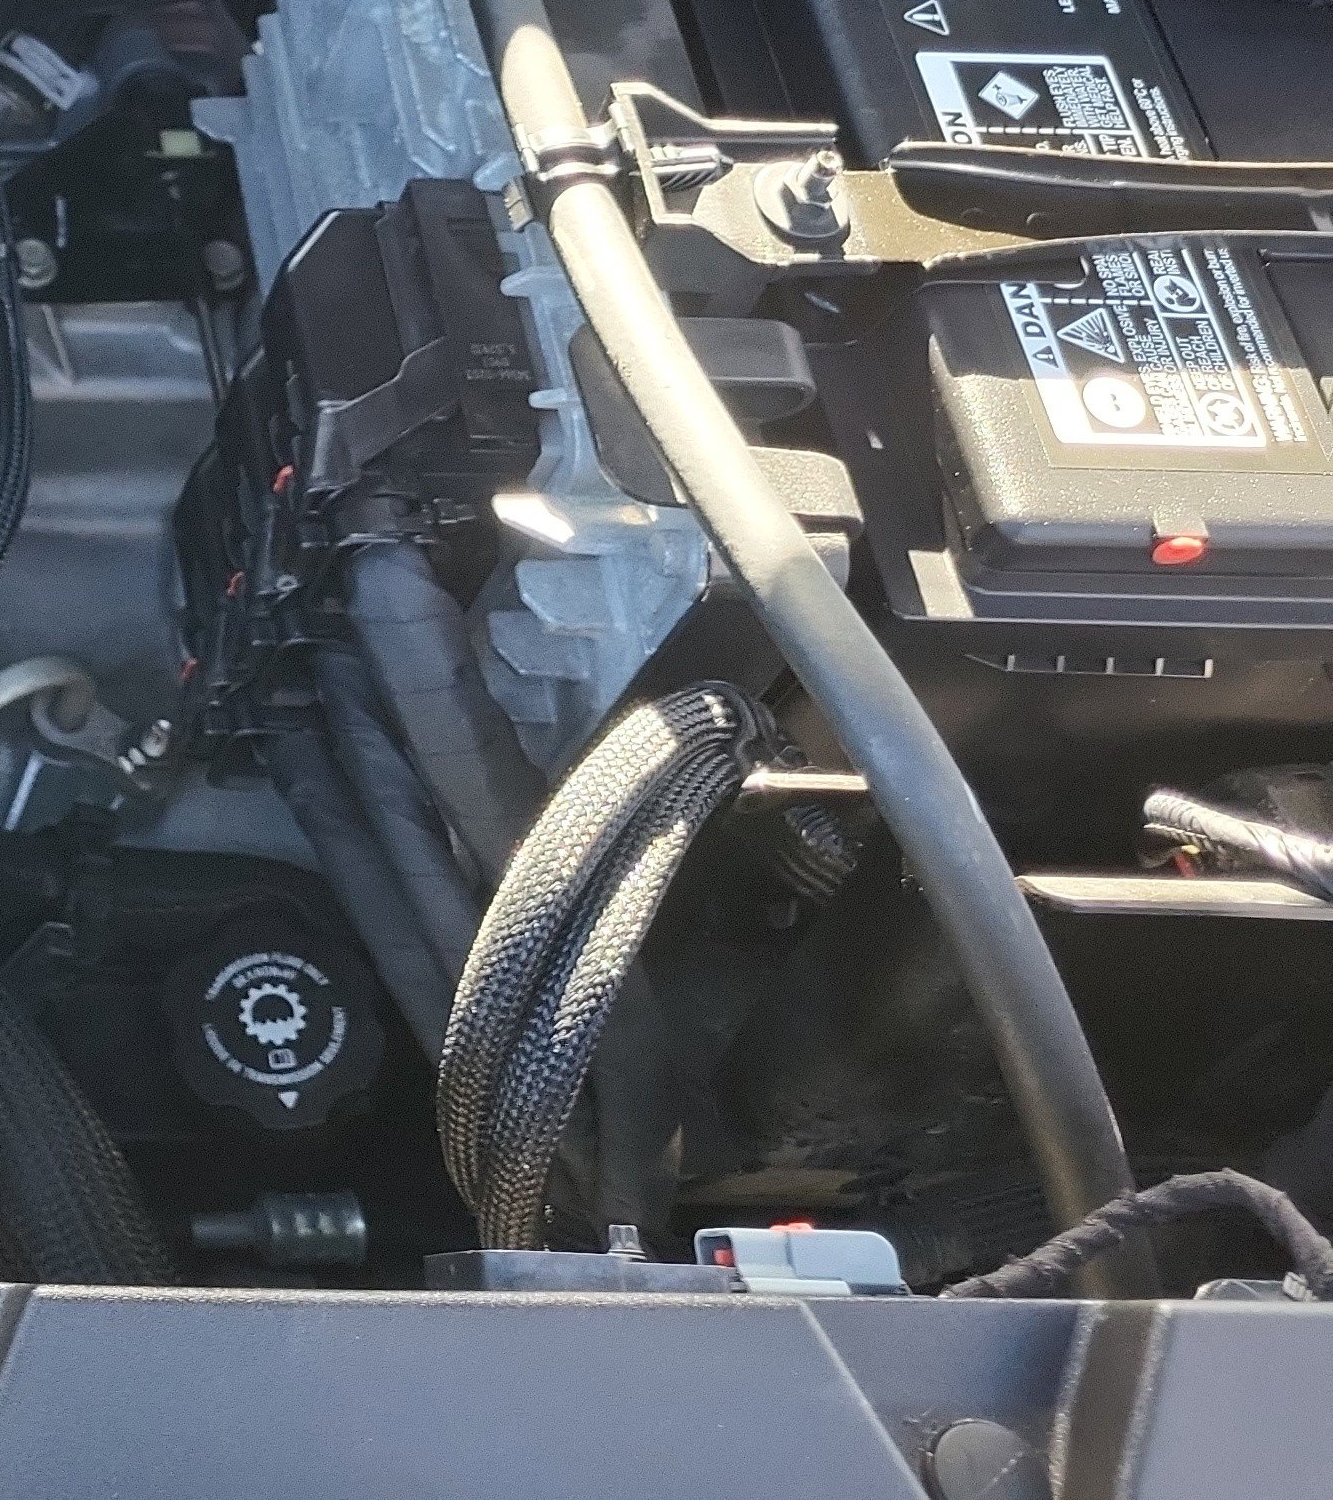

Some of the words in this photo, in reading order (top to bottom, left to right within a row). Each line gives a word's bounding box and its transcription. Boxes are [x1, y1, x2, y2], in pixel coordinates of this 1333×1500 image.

[1052, 65, 1088, 127] IMMEDIATELY
[1077, 64, 1105, 106] MEDICAL
[1093, 76, 1115, 102] FAST.
[1051, 95, 1076, 126] FLUSH
[1079, 102, 1101, 127] WITH
[1093, 107, 1113, 127] GET
[1104, 102, 1127, 128] HELP
[940, 111, 973, 144] ON
[1097, 133, 1119, 151] TIP
[1114, 136, 1138, 155] EN.
[1090, 254, 1113, 278] SPA
[1103, 254, 1132, 296] FLAMES
[1116, 252, 1139, 279] SMO
[1210, 268, 1225, 279] or
[1219, 259, 1245, 294] inverted
[1099, 279, 1120, 295] NO
[1127, 280, 1146, 296] OR
[1004, 282, 1046, 337] DAN
[1214, 279, 1245, 323] explosion
[1234, 295, 1252, 308] for
[1113, 304, 1147, 361] EXPLOSIVE
[1144, 318, 1170, 355] INJURY
[1241, 309, 1281, 375] recommended
[1138, 334, 1164, 370] CAUSE
[1175, 336, 1196, 359] OUT
[1188, 335, 1214, 372] REACH
[1195, 320, 1228, 373] CHILDREN
[1237, 341, 1256, 352] of
[1160, 356, 1177, 372] OR
[1184, 361, 1207, 389] KEEP
[1243, 352, 1266, 374] Risk
[1217, 373, 1237, 391] OF
